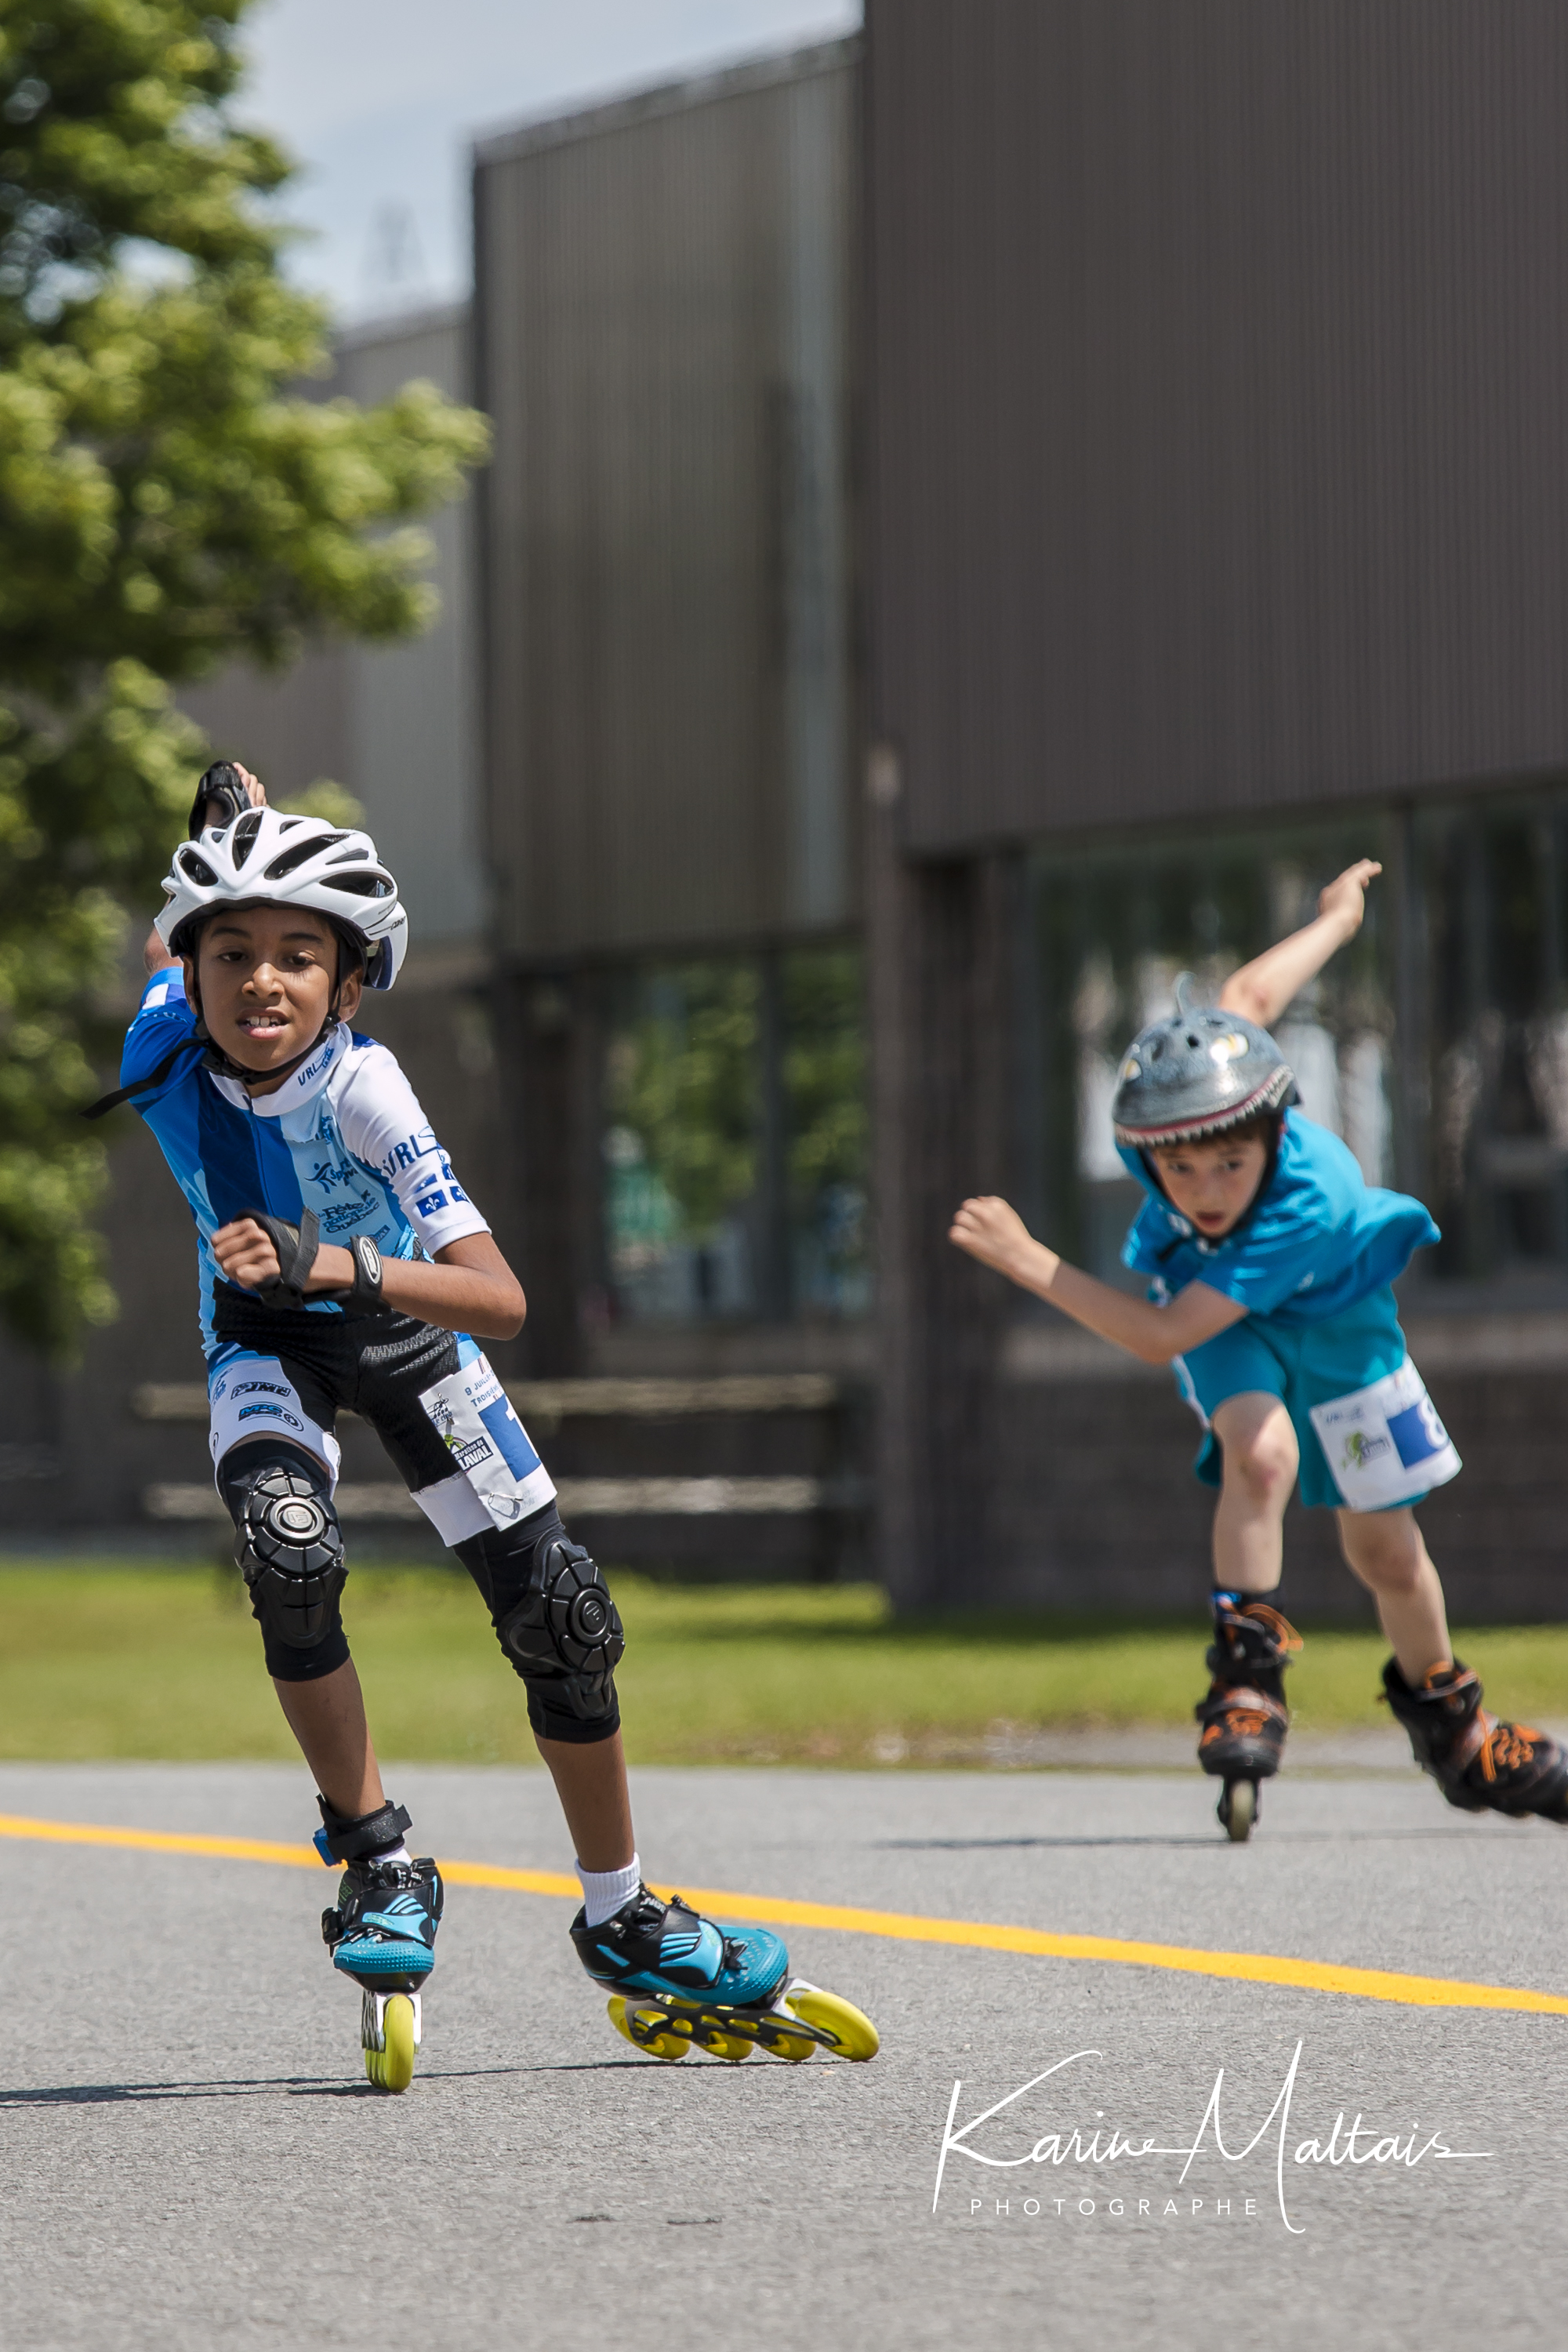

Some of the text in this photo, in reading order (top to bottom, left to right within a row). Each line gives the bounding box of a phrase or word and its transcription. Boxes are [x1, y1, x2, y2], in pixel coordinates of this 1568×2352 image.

[382, 1134, 438, 1178] VRL
[322, 1203, 365, 1220] Fête
[326, 1202, 379, 1233] Québec
[458, 1446, 492, 1472] LAVAL
